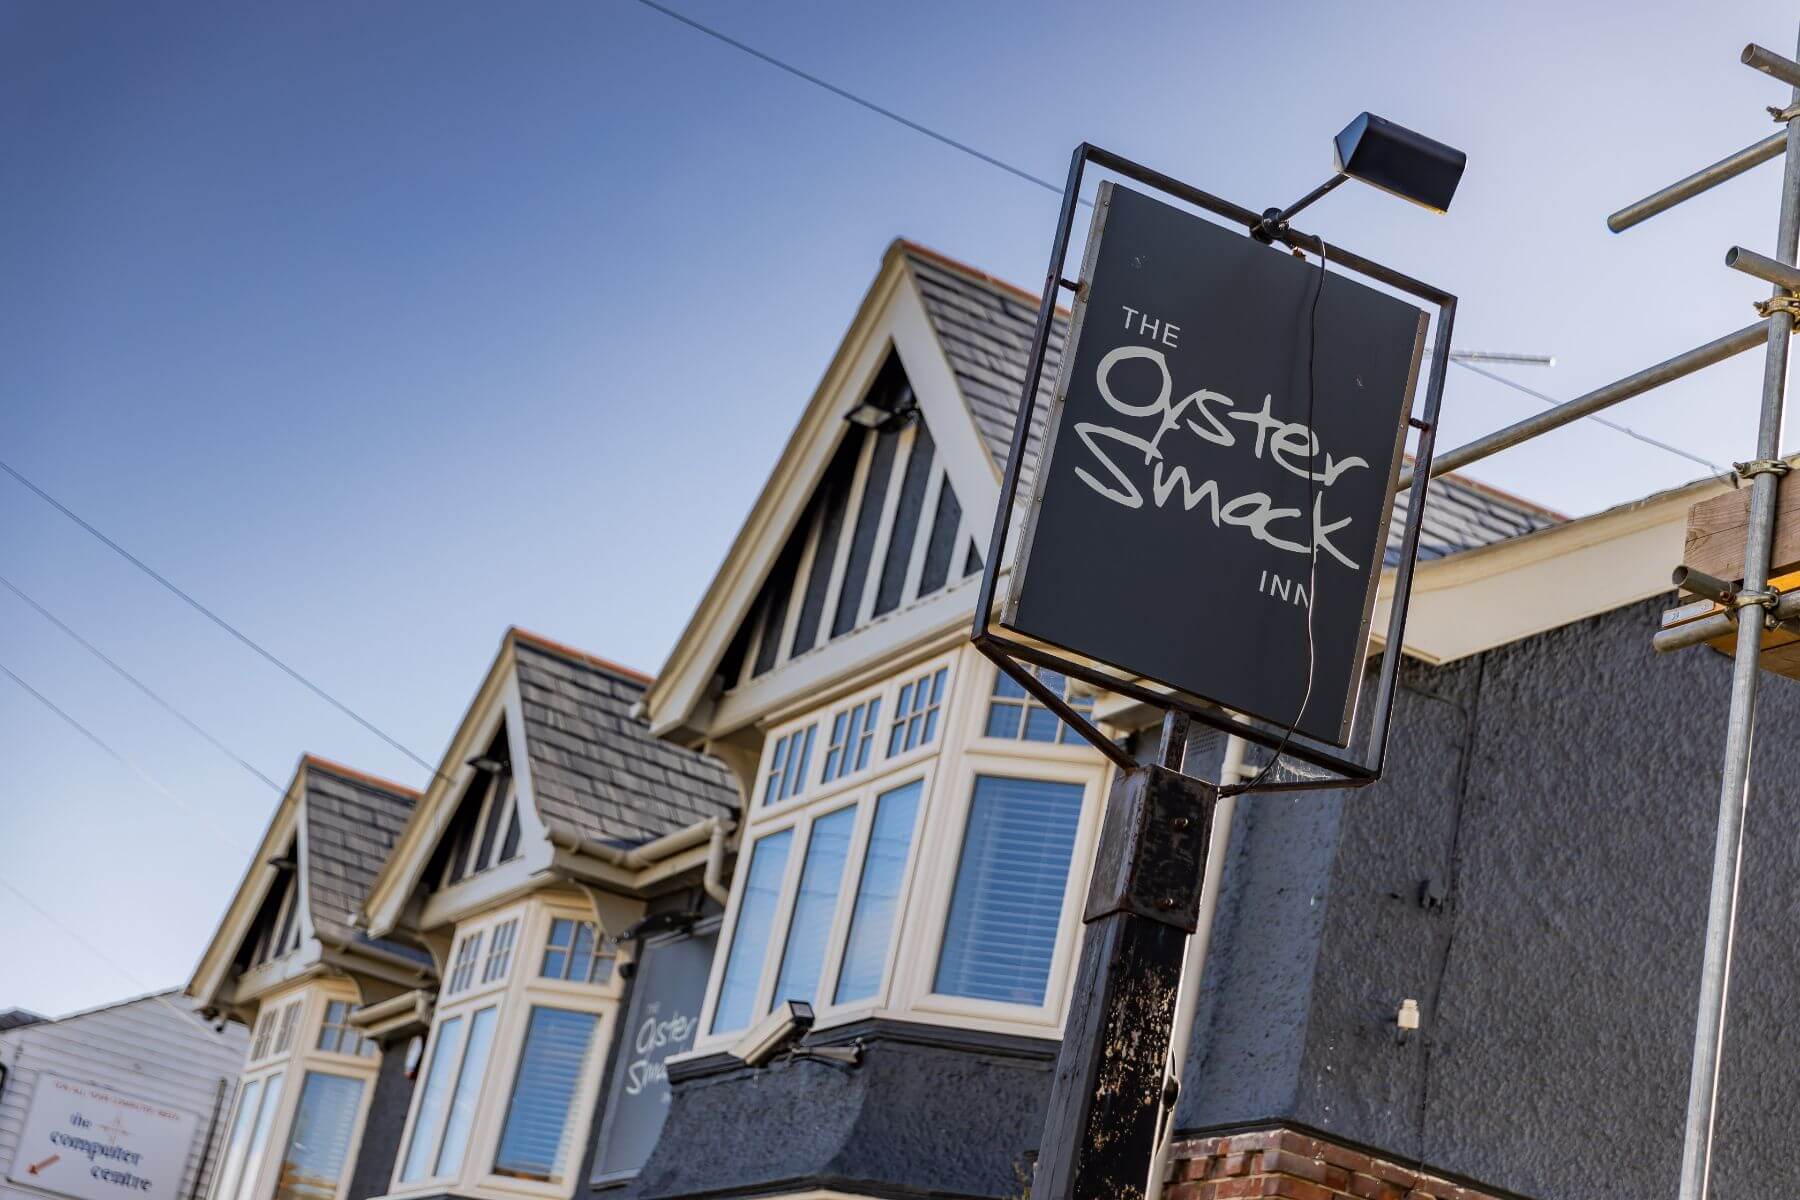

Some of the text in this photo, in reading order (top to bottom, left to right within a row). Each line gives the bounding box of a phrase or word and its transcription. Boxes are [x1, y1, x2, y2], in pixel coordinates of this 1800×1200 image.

[1122, 305, 1181, 348] THE
[1096, 345, 1370, 486] Oyster
[1074, 422, 1360, 570] Smack
[49, 1131, 142, 1165] computer
[90, 1165, 152, 1191] centre
